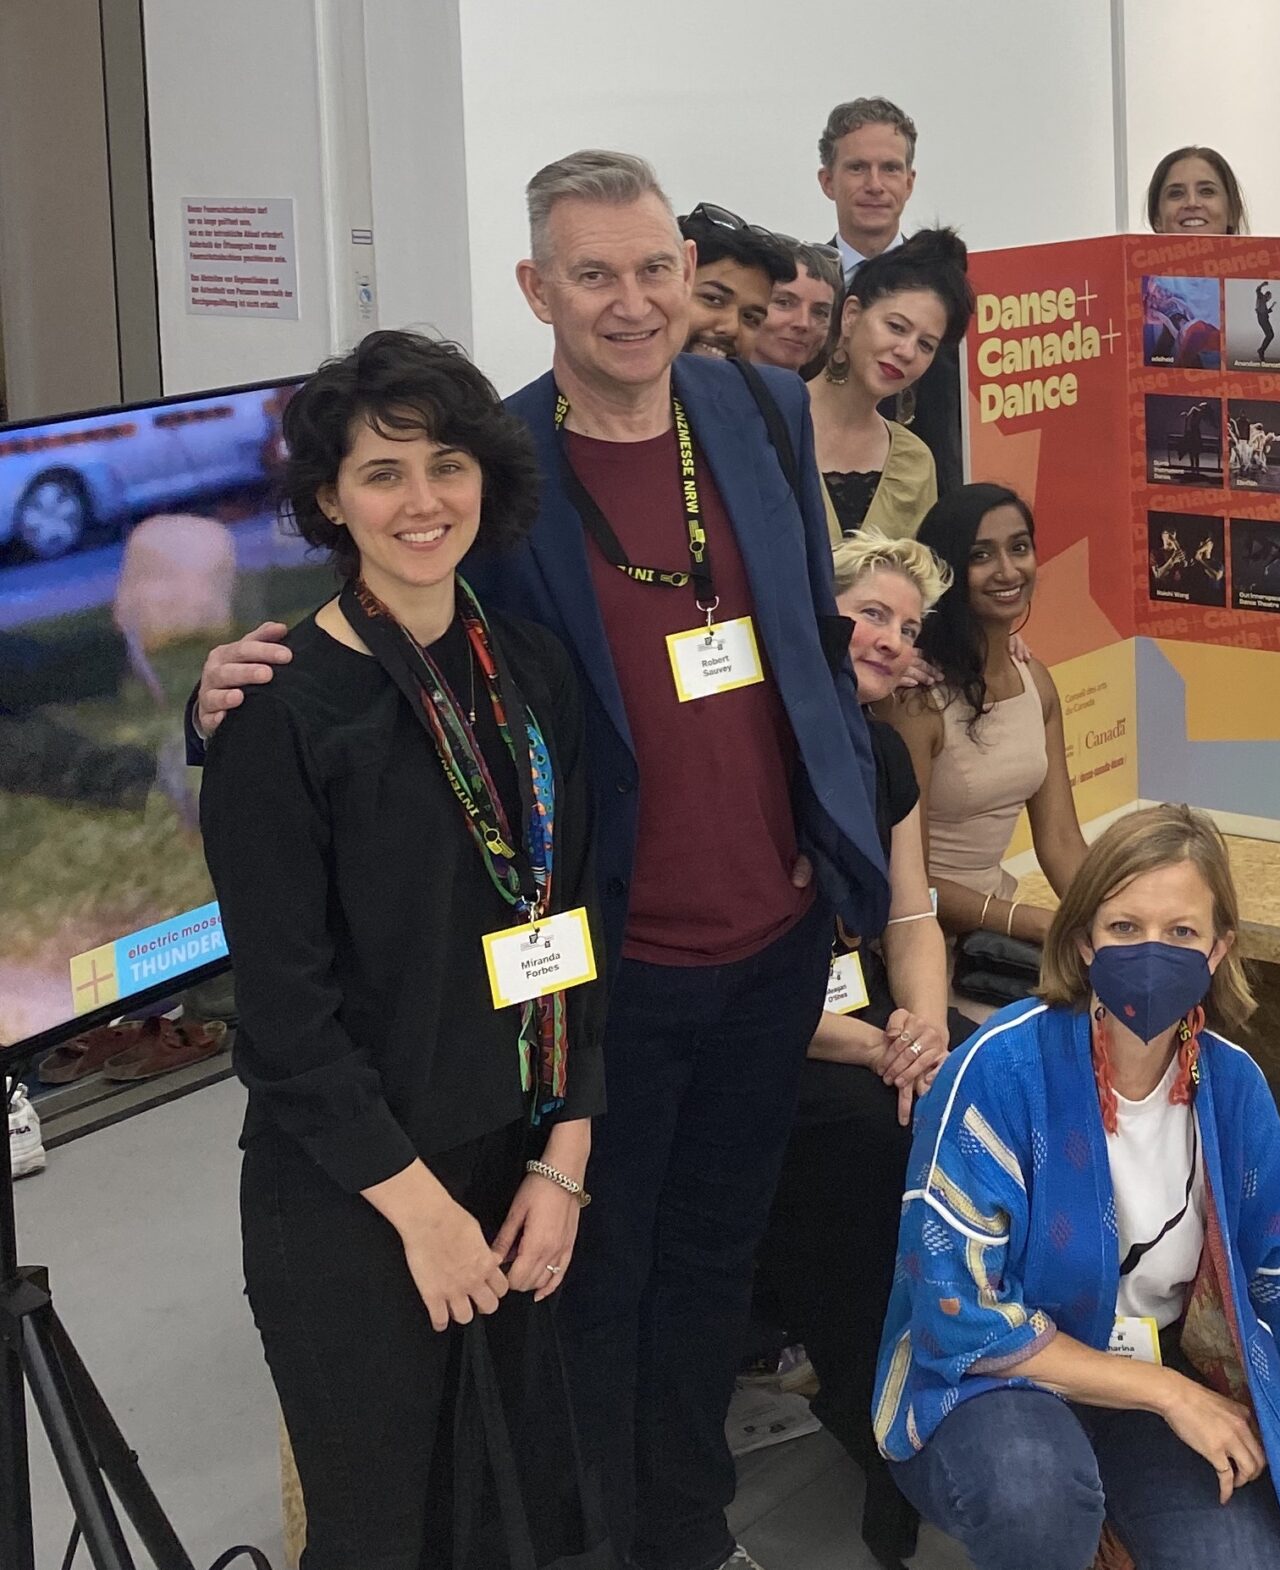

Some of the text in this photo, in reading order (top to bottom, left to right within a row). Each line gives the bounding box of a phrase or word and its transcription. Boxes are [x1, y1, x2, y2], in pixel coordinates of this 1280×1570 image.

[980, 372, 1078, 424] Dance
[684, 480, 700, 514] NRW
[701, 655, 729, 668] Robert
[703, 664, 732, 678] Sauvey
[1085, 717, 1126, 750] Canada
[128, 930, 179, 960] electric
[130, 931, 224, 983] THUNDER
[521, 952, 561, 970] Miranda
[525, 963, 560, 979] Forbes
